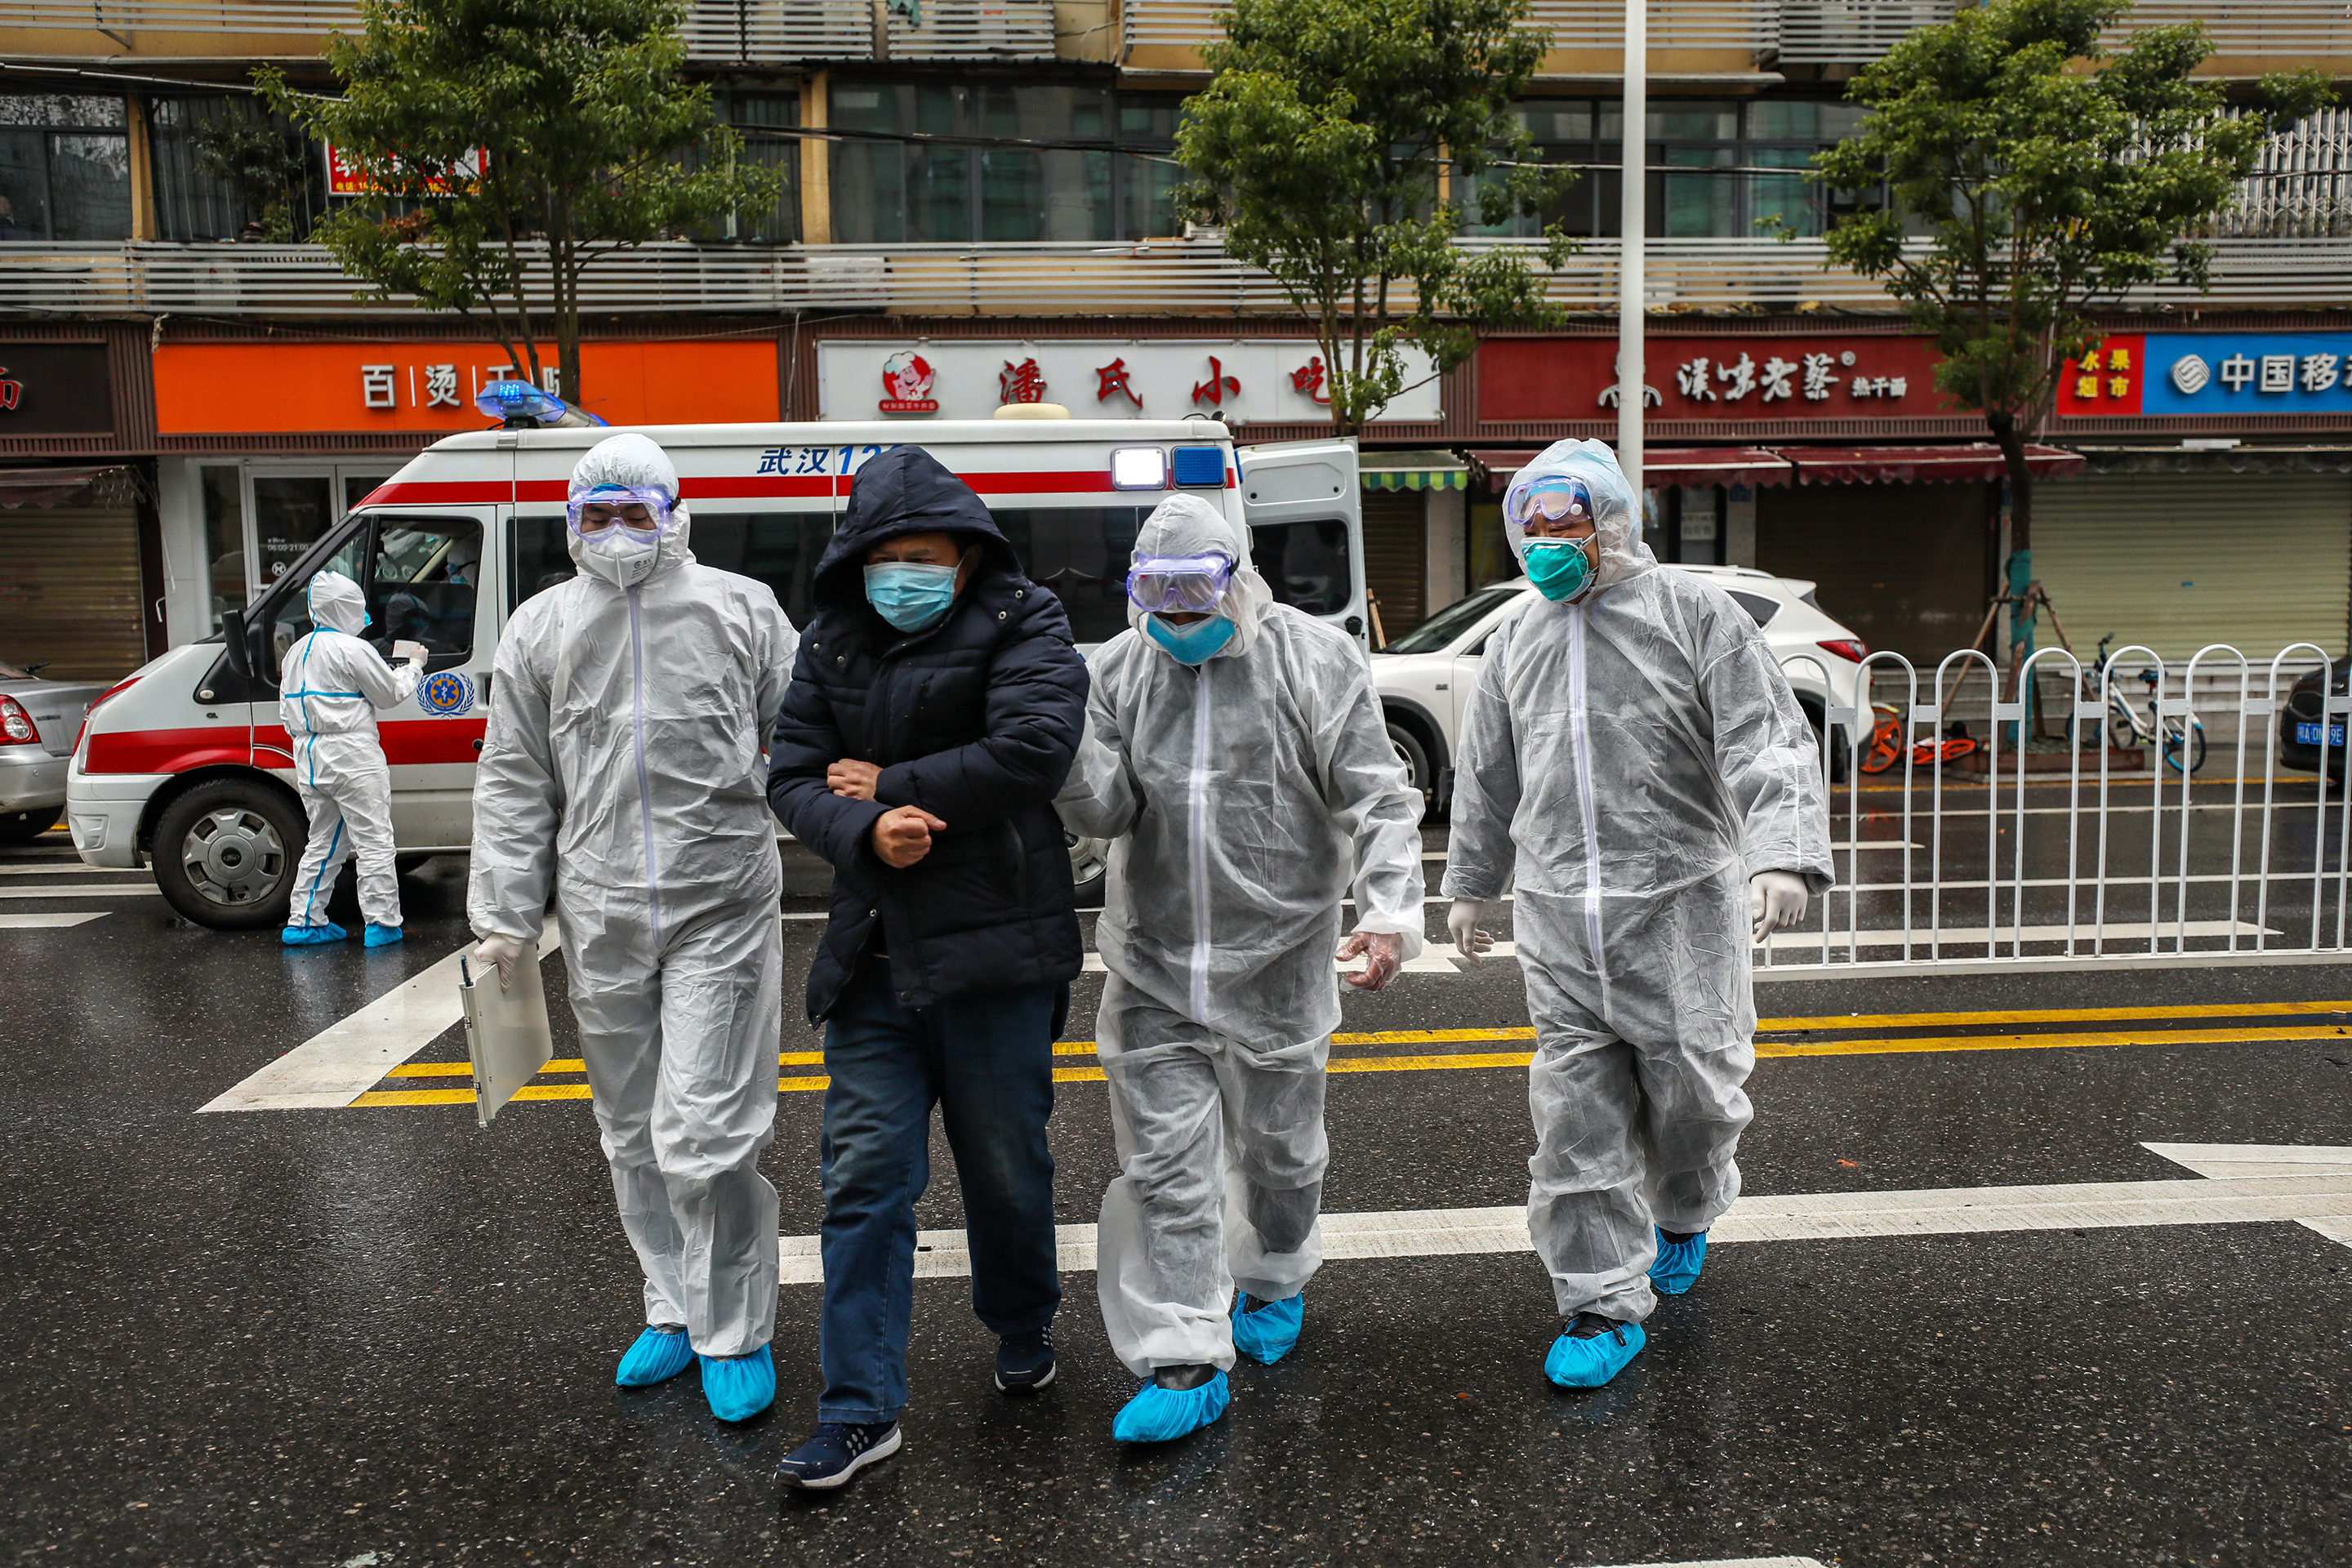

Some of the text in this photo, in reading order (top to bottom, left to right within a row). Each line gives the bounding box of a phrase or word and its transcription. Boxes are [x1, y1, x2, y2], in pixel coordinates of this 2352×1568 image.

[2076, 349, 2130, 372] 水果
[2220, 352, 2352, 393] 中国移
[999, 355, 1330, 408] 潘氏小吃
[1851, 376, 1908, 397] 热干面
[2075, 376, 2130, 398] 超市
[756, 447, 830, 475] 武汉
